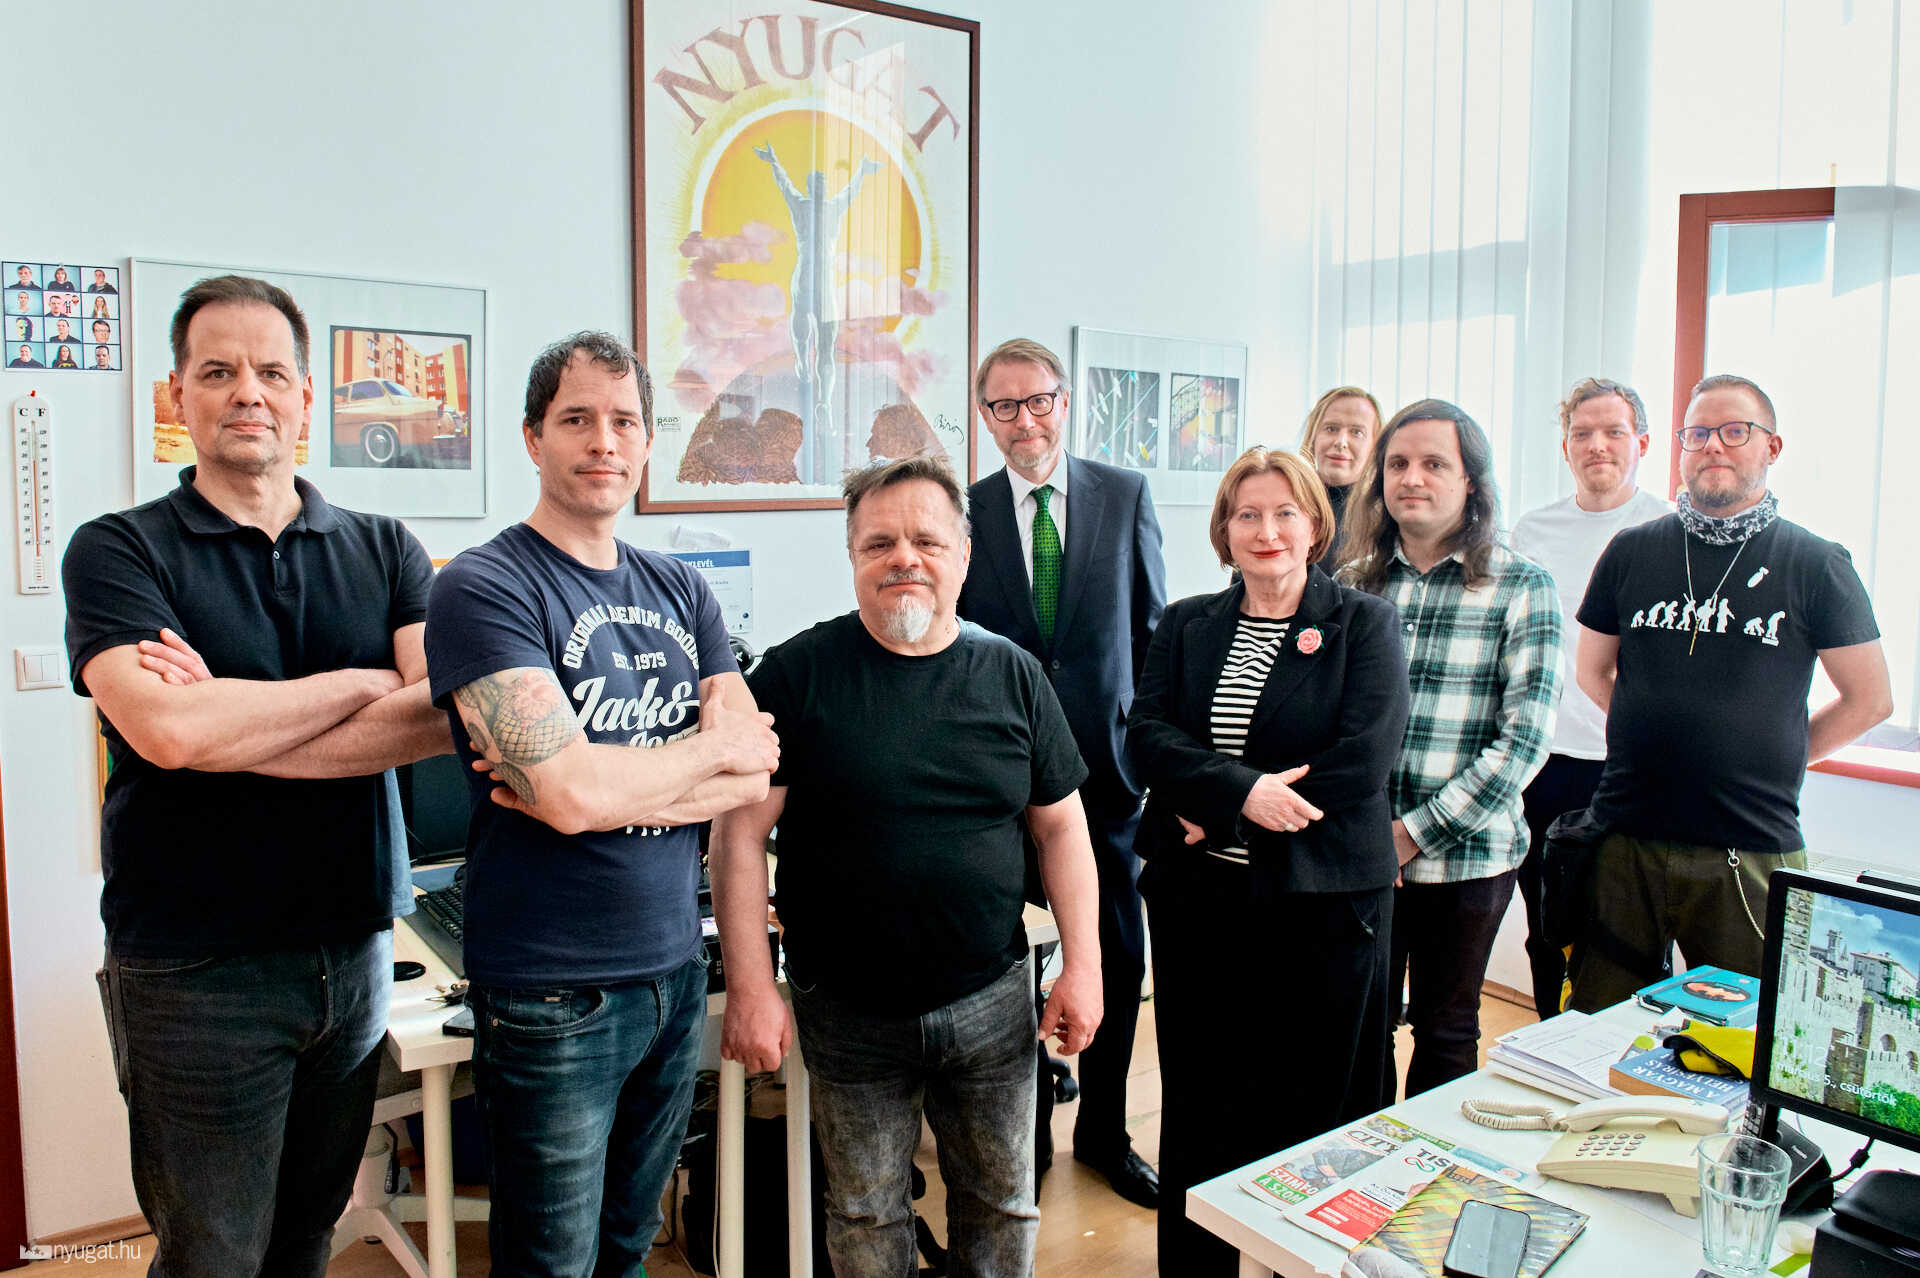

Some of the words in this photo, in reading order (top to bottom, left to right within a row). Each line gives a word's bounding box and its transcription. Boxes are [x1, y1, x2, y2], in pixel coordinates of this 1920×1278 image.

[652, 14, 960, 153] NYUGAT
[607, 604, 661, 630] DENIM
[634, 651, 668, 671] 1975
[1632, 1065, 1705, 1095] MAGYAR
